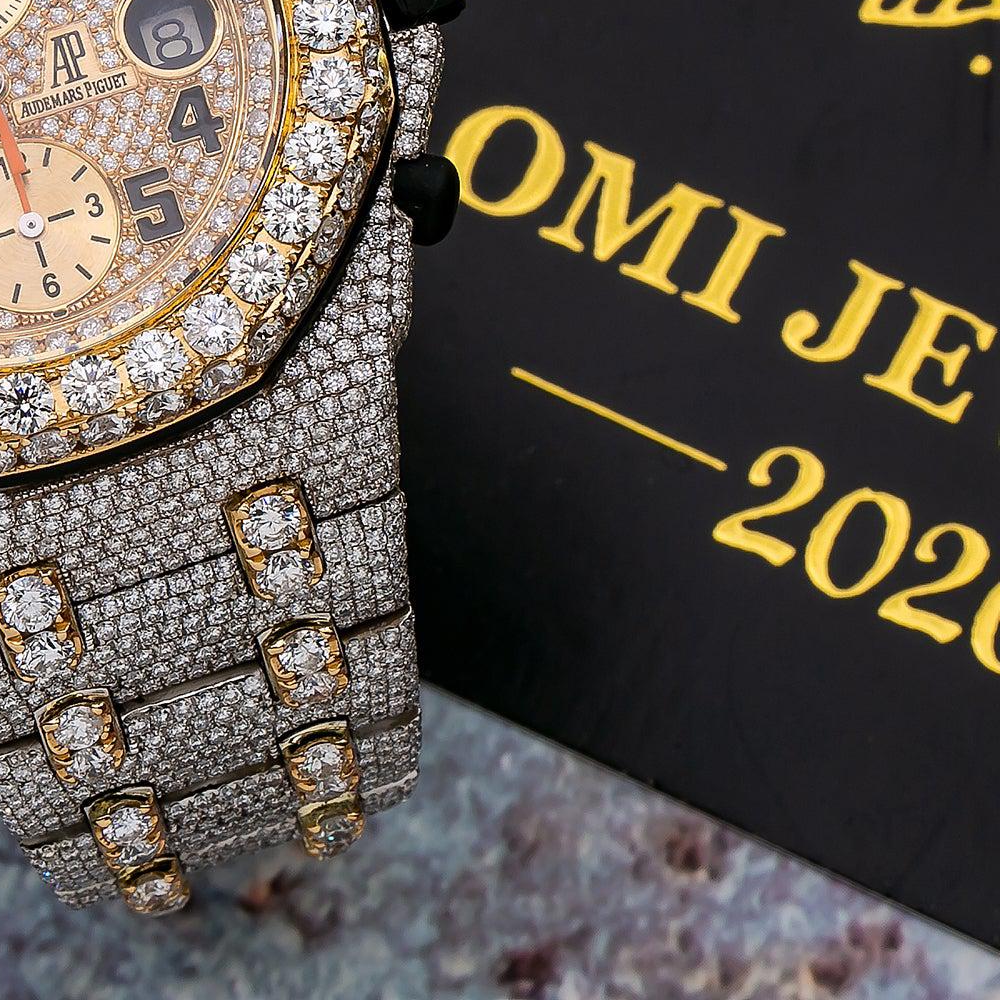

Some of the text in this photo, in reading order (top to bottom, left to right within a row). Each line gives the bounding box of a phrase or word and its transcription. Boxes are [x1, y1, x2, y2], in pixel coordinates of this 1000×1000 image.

[50, 30, 88, 88] AP
[152, 18, 193, 62] 8
[20, 72, 128, 119] AUDEMARS PIGUET
[167, 84, 226, 156] 4
[85, 193, 104, 217] 3
[122, 166, 186, 244] 5
[445, 104, 787, 324] OMI
[42, 273, 61, 298] 6
[712, 446, 1000, 678] 202
